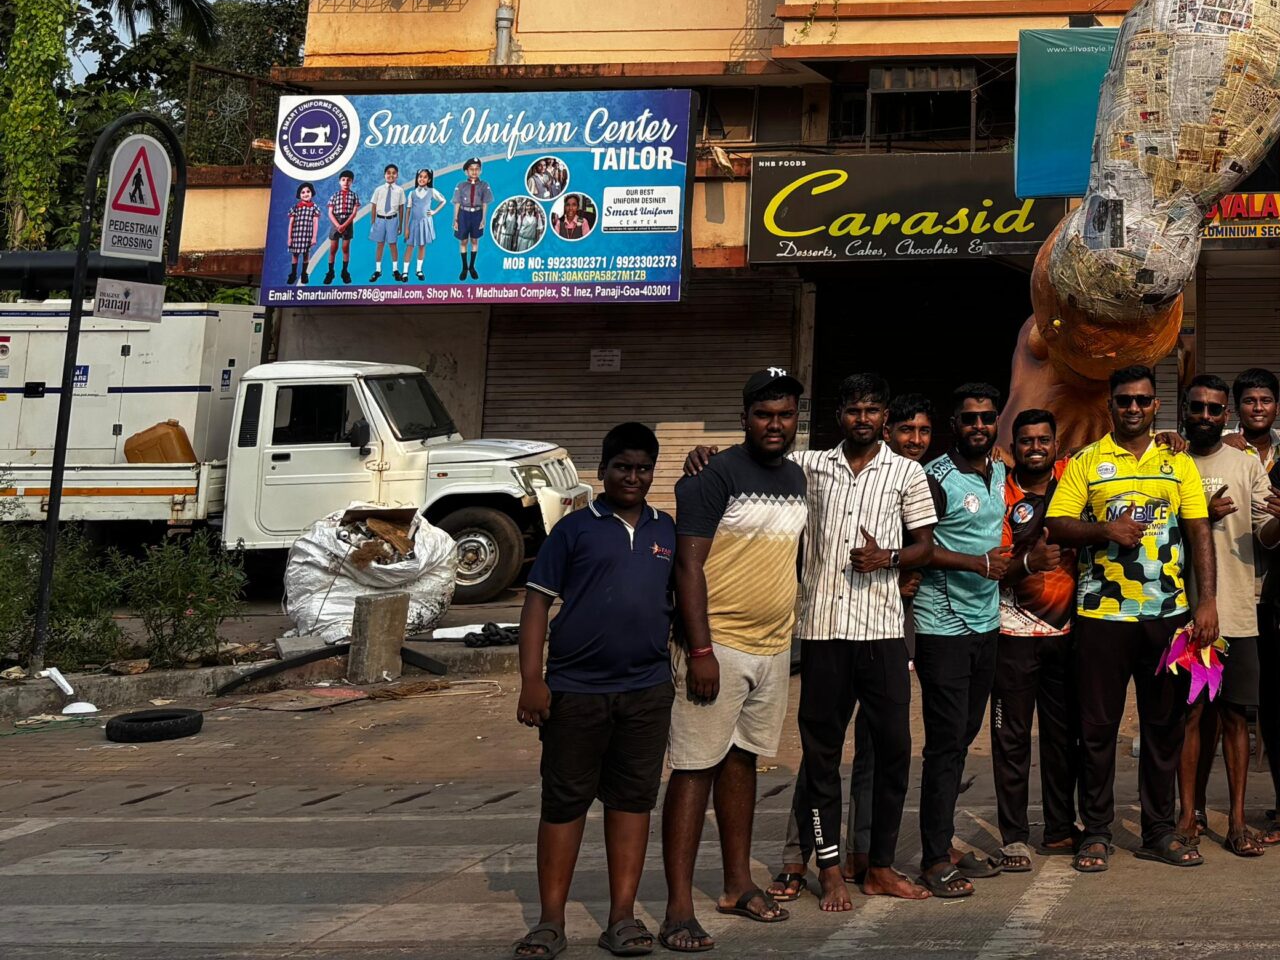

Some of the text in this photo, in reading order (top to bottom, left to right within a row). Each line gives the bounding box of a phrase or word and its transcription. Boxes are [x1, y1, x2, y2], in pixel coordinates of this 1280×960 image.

[282, 101, 348, 131] SMART UNIFORMS CENTER
[364, 106, 679, 162] Smart Uniform Center
[282, 144, 344, 168] MANUFACTURING EXPERT
[590, 146, 673, 171] TAILOR
[604, 206, 674, 217] Smart Uniform
[763, 169, 1035, 237] Carasid
[108, 219, 159, 236] PEDESTRIAN
[111, 235, 153, 249] CROSSING
[776, 241, 837, 259] Desserts,
[845, 240, 887, 258] Cakes,
[503, 255, 677, 270] MOB NO: 9923302371 / 9923302373
[268, 286, 671, 302] Email: Smartuniforms786@gmail.com, Shop No. 1, Madhuban Complex, St. Inez, Panaji-Goa-403001
[97, 298, 131, 315] panaji
[811, 808, 824, 846] PRIDE
